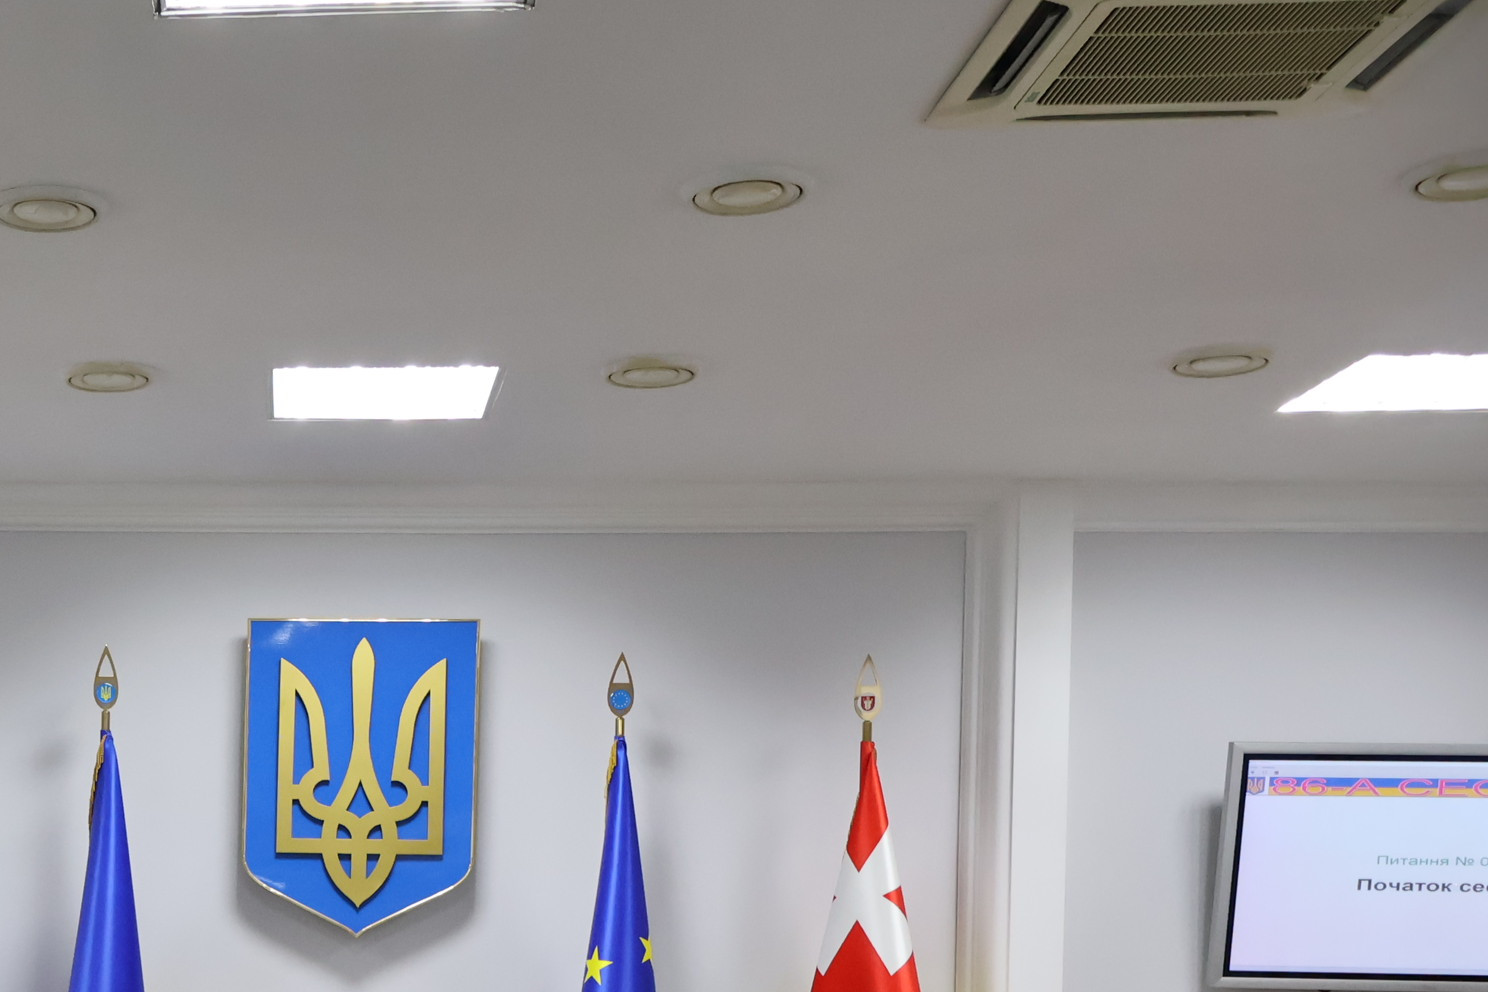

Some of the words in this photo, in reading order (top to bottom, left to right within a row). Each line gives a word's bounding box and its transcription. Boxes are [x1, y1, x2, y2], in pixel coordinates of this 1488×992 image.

[1377, 855, 1449, 866] Питання
[1357, 878, 1452, 892] Початок
[1460, 882, 1488, 893] се
